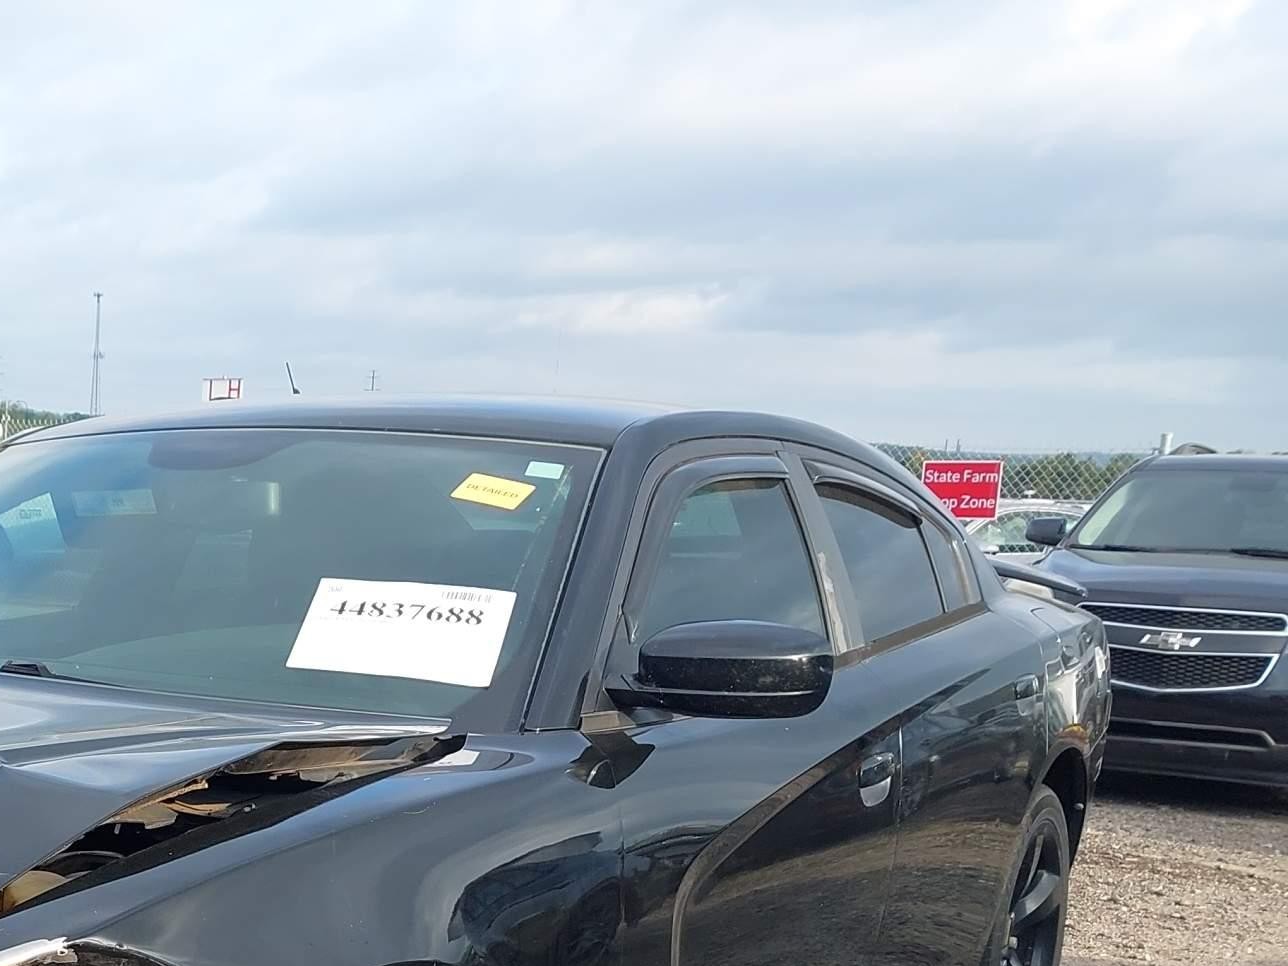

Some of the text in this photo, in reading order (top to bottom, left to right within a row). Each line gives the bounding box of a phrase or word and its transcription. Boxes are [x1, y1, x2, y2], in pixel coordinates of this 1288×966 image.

[925, 469, 999, 483] State Farm
[940, 494, 996, 511] op Zone
[329, 599, 485, 626] 44837688
